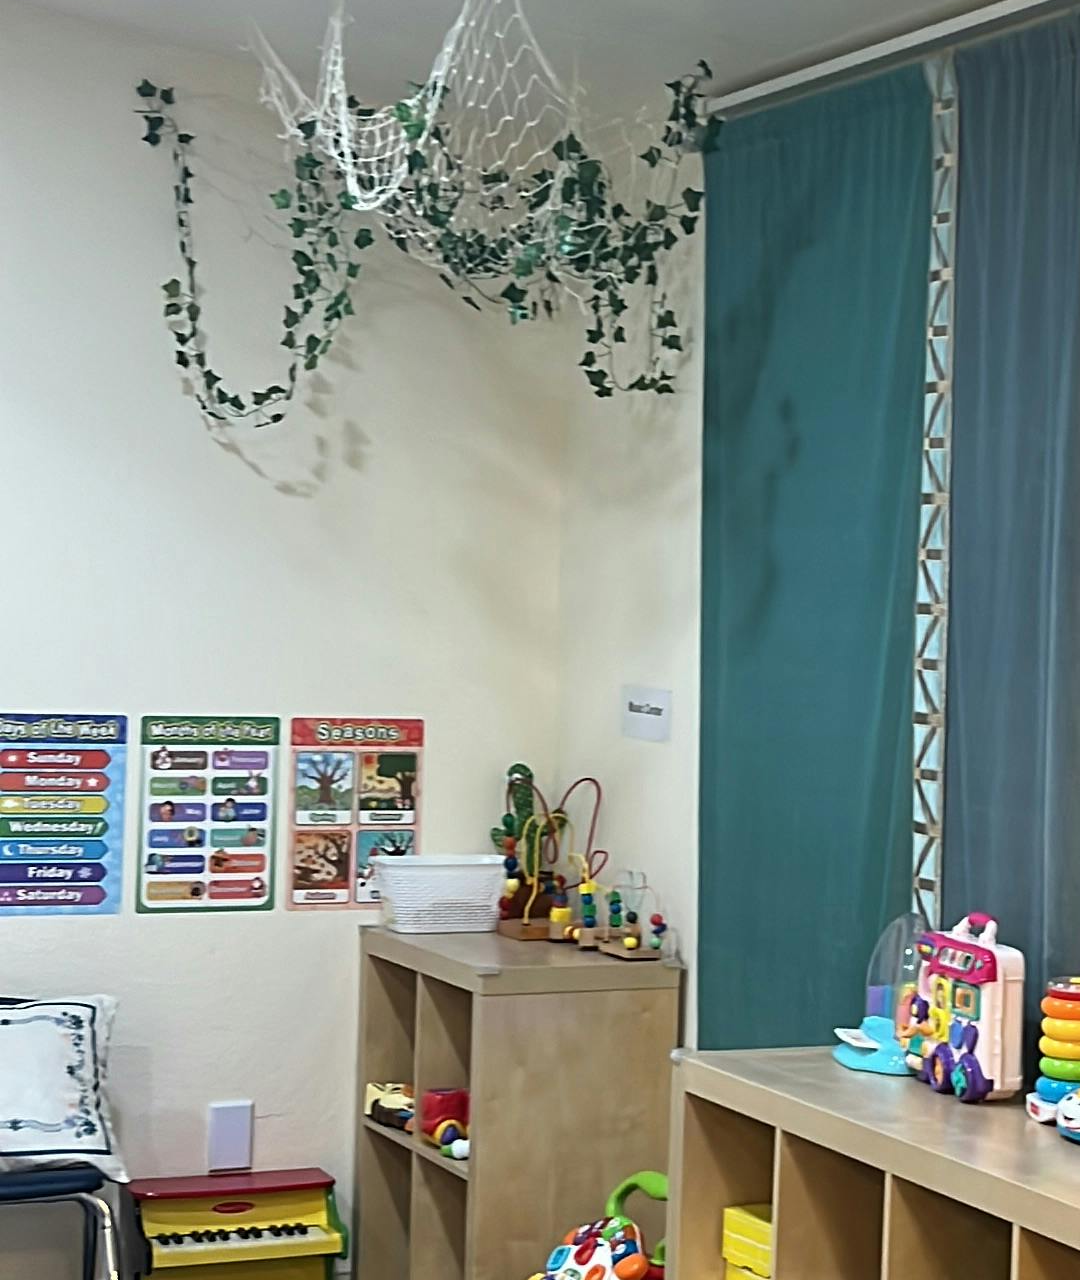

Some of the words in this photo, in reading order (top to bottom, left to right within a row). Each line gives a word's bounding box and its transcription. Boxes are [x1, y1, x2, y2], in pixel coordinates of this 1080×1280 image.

[78, 721, 118, 739] Week
[149, 722, 199, 738] Months
[202, 722, 219, 738] of
[219, 722, 240, 739] the
[240, 722, 272, 739] Year
[316, 722, 401, 741] Seasons
[27, 751, 81, 766] Sunday
[25, 775, 83, 789] Monday
[24, 797, 82, 812] Tuesday
[8, 821, 95, 835] Wednesday
[17, 843, 84, 857] Thursday
[27, 866, 75, 880] Friday
[15, 889, 83, 902] Saturday
